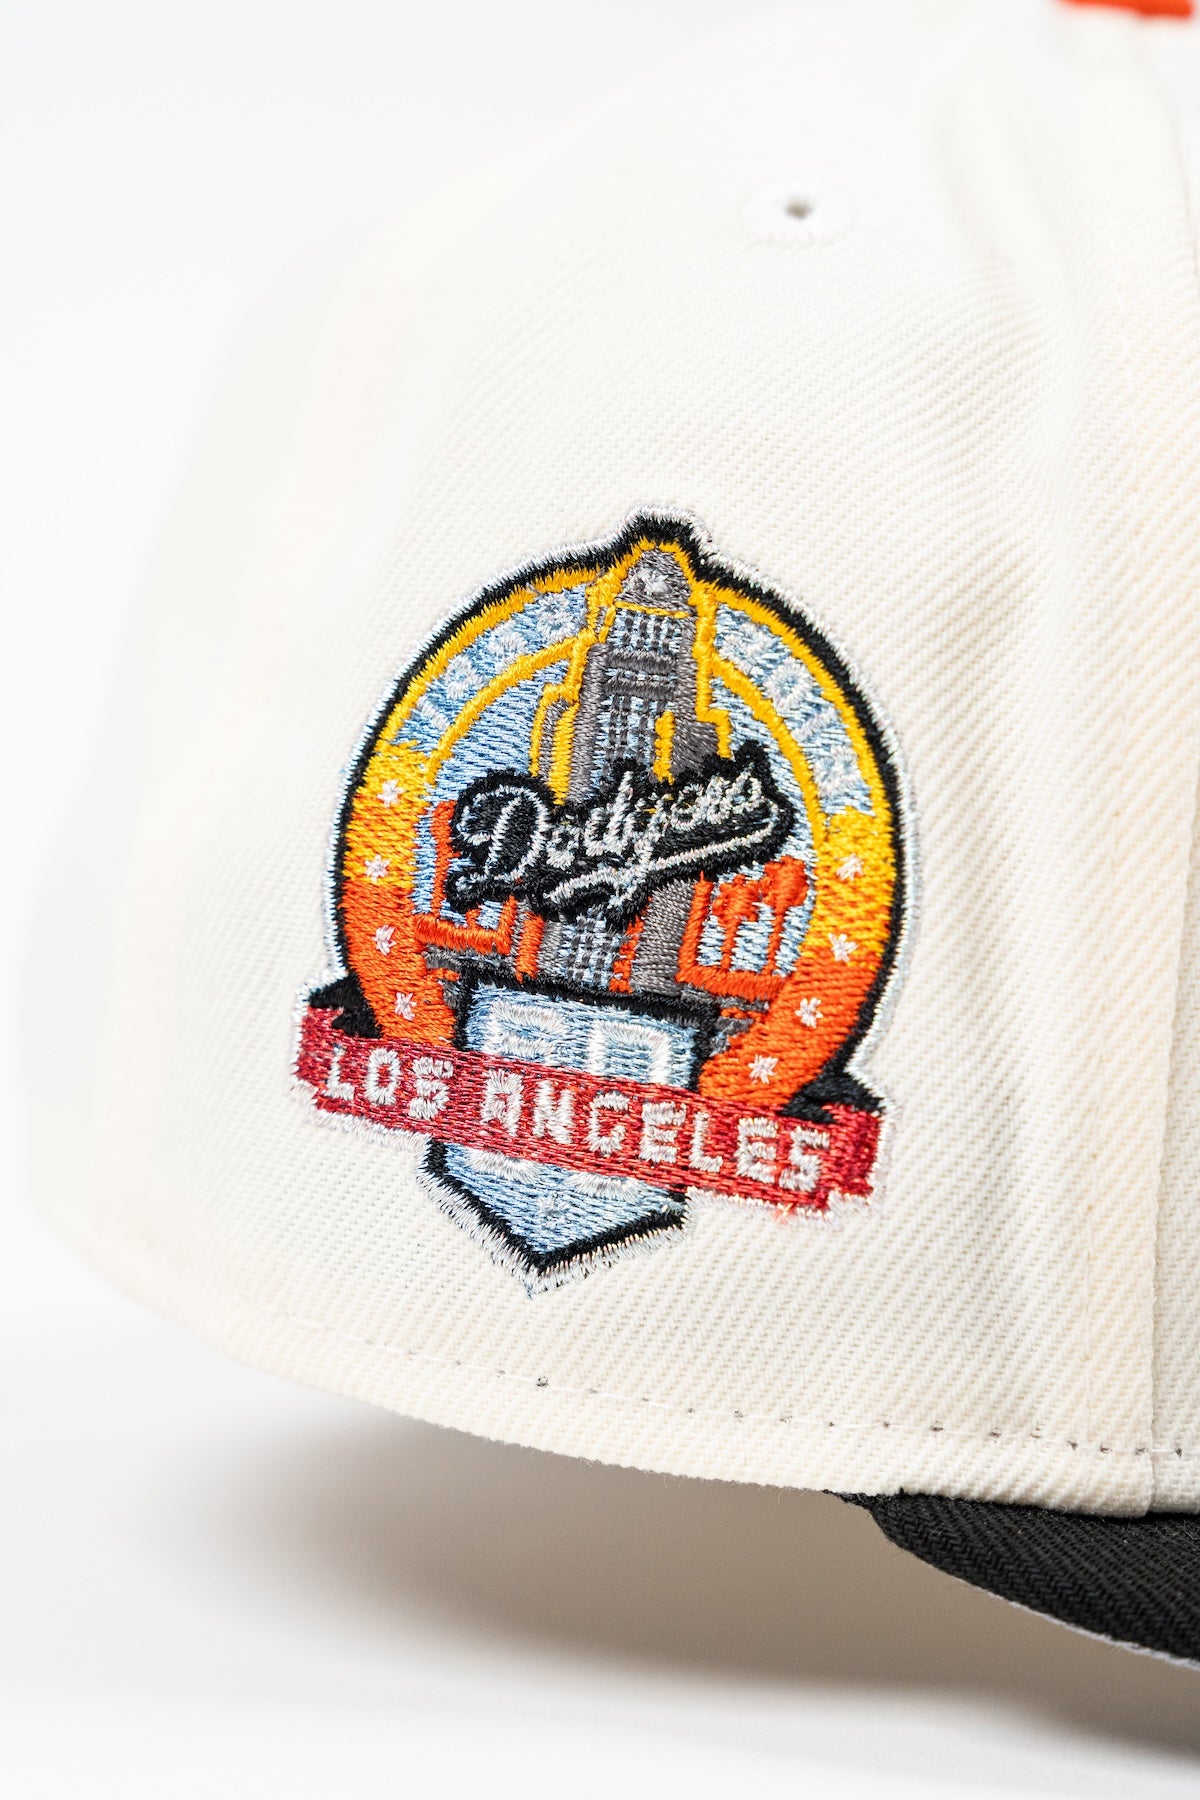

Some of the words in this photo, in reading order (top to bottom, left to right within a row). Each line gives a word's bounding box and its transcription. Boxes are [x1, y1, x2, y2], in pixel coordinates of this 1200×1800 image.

[455, 763, 779, 908] Dodgers
[321, 1046, 454, 1121] LOS
[480, 1067, 831, 1192] ANGELES
